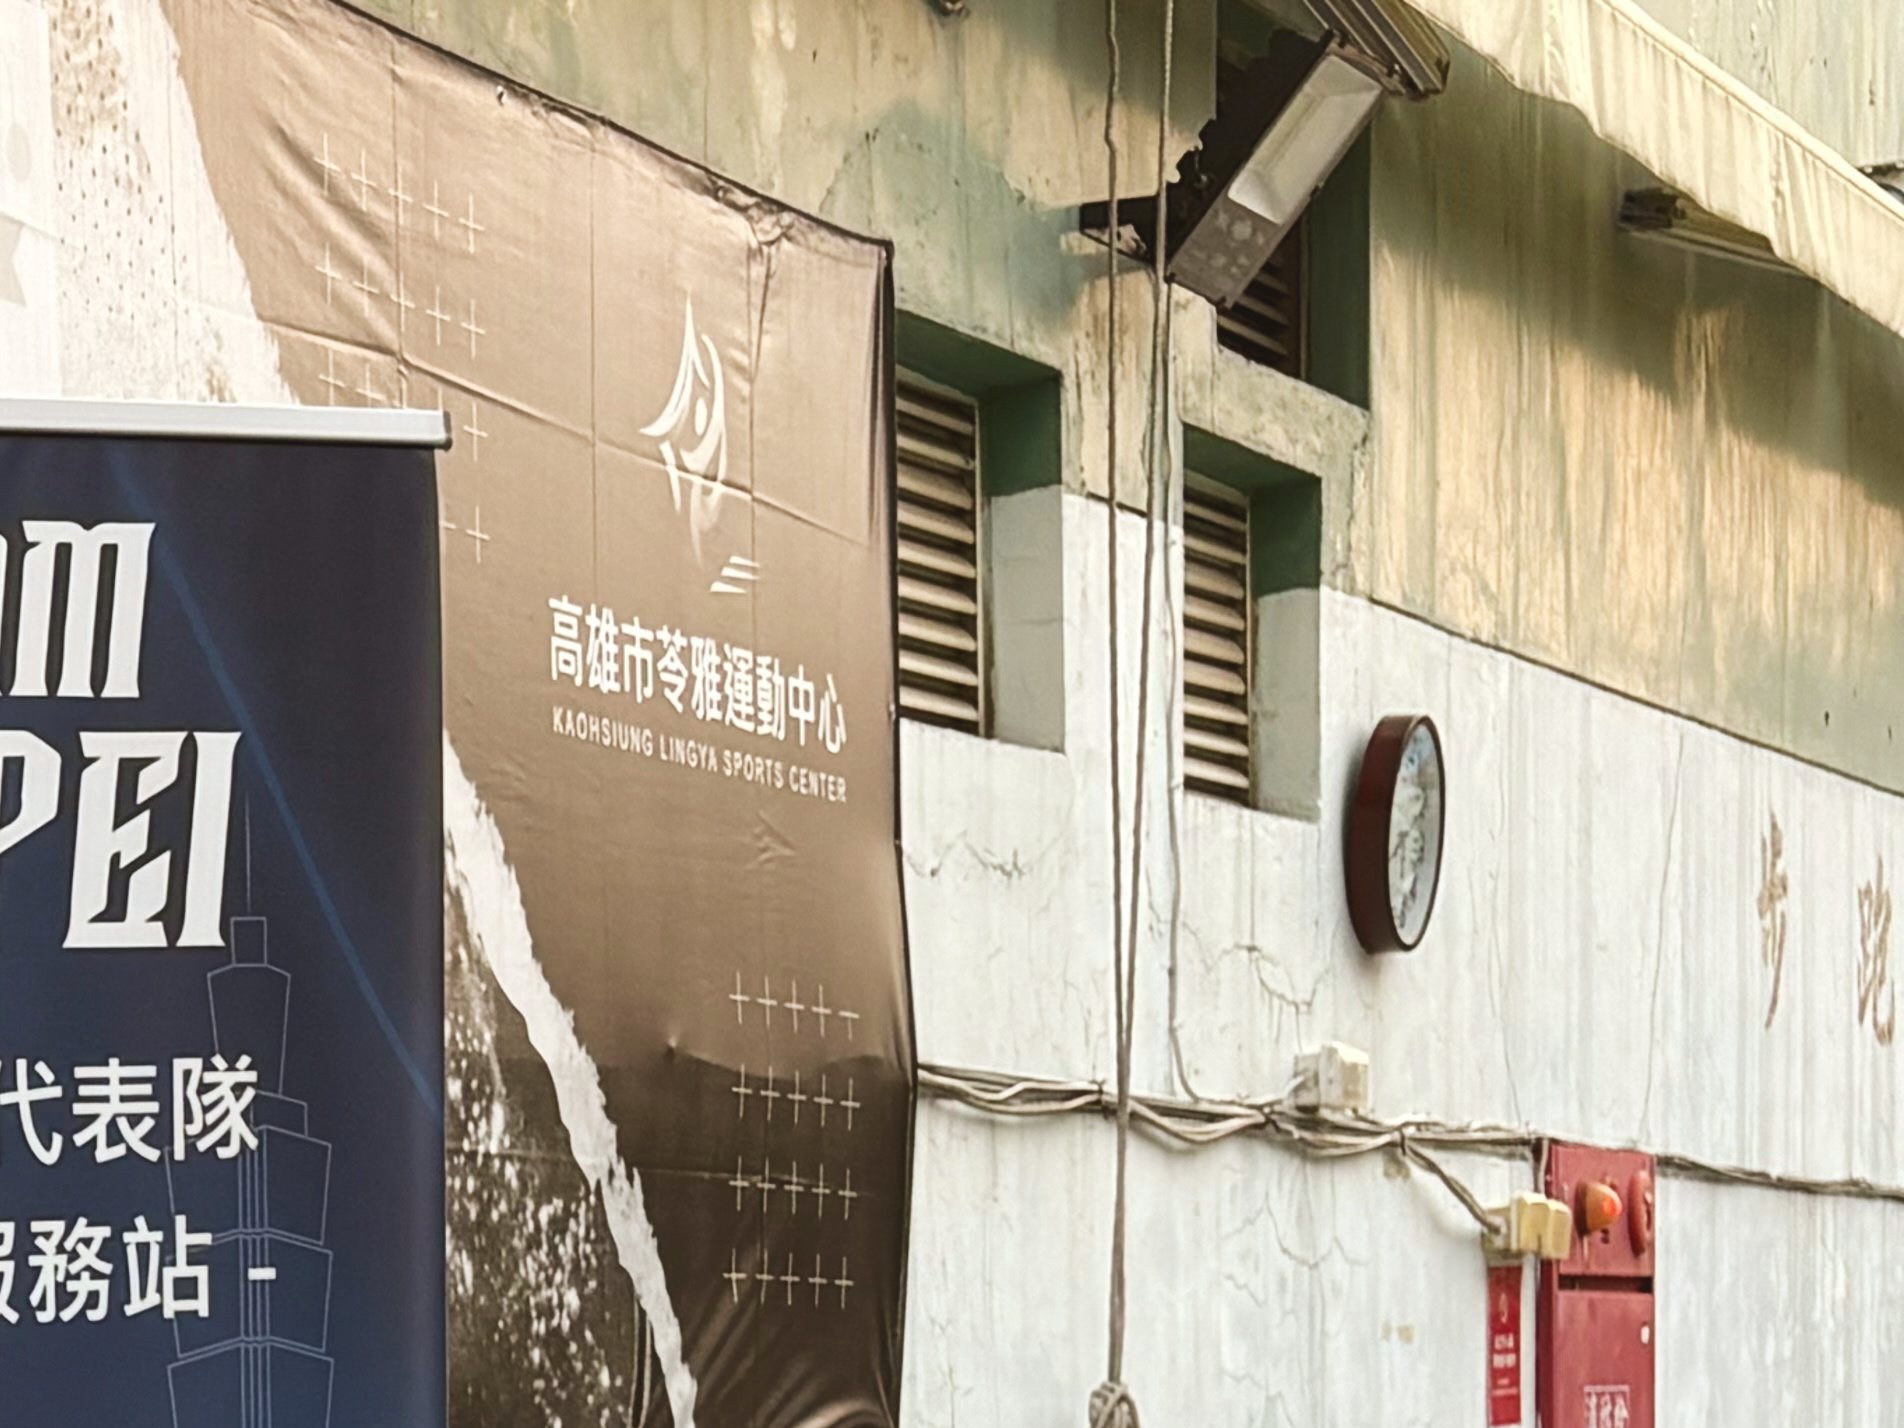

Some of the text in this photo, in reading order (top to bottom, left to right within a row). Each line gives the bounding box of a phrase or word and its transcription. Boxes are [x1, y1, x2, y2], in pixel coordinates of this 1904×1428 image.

[549, 595, 847, 754] 高雄市苓雅運動中心
[552, 706, 847, 802] KAOHSIUNG LINGYA SPORTS CENTER
